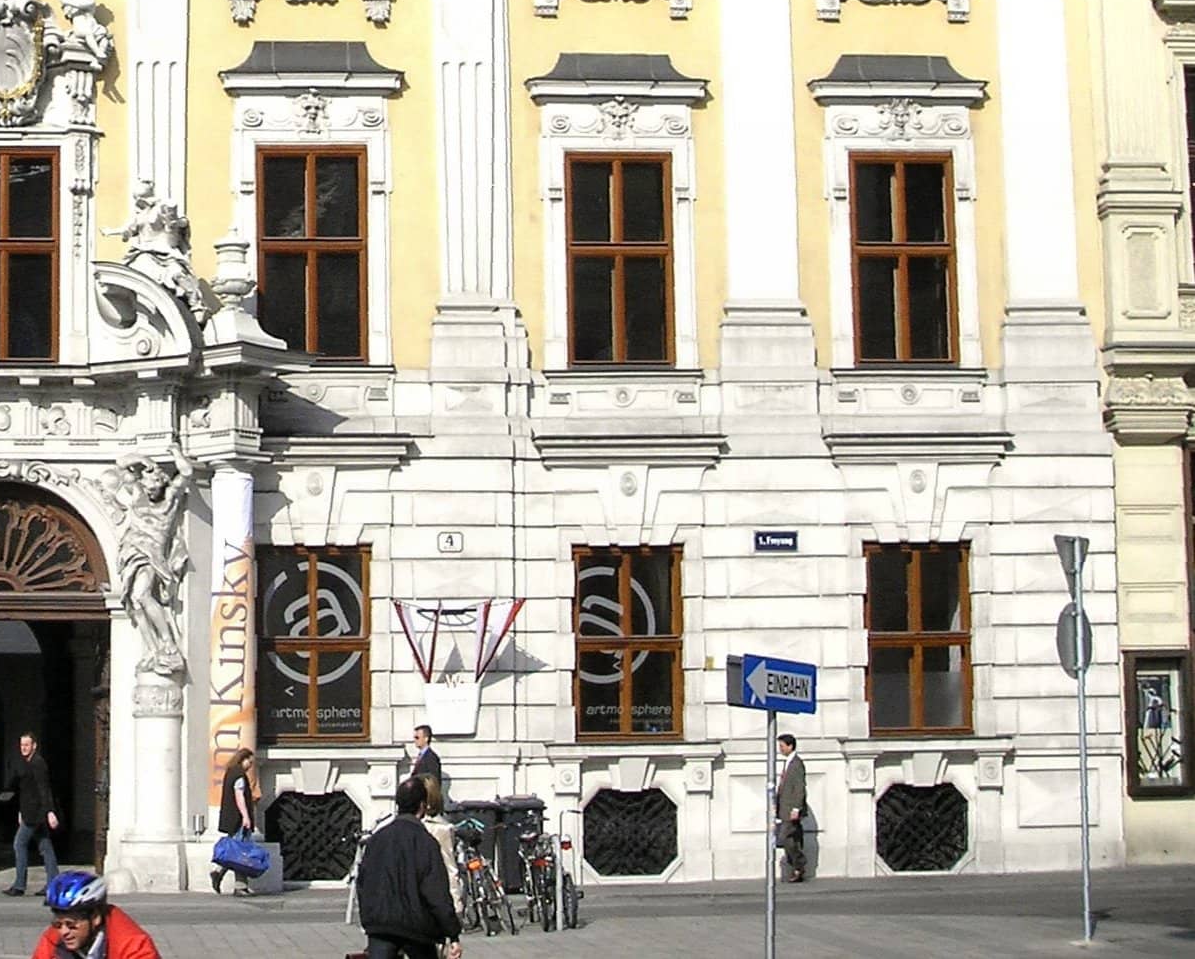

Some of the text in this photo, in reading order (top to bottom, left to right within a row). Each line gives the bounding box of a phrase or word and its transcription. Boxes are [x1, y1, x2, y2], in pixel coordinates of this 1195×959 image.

[445, 535, 454, 546] 4
[210, 537, 254, 711] Kinsky
[766, 673, 810, 699] EINBAHN
